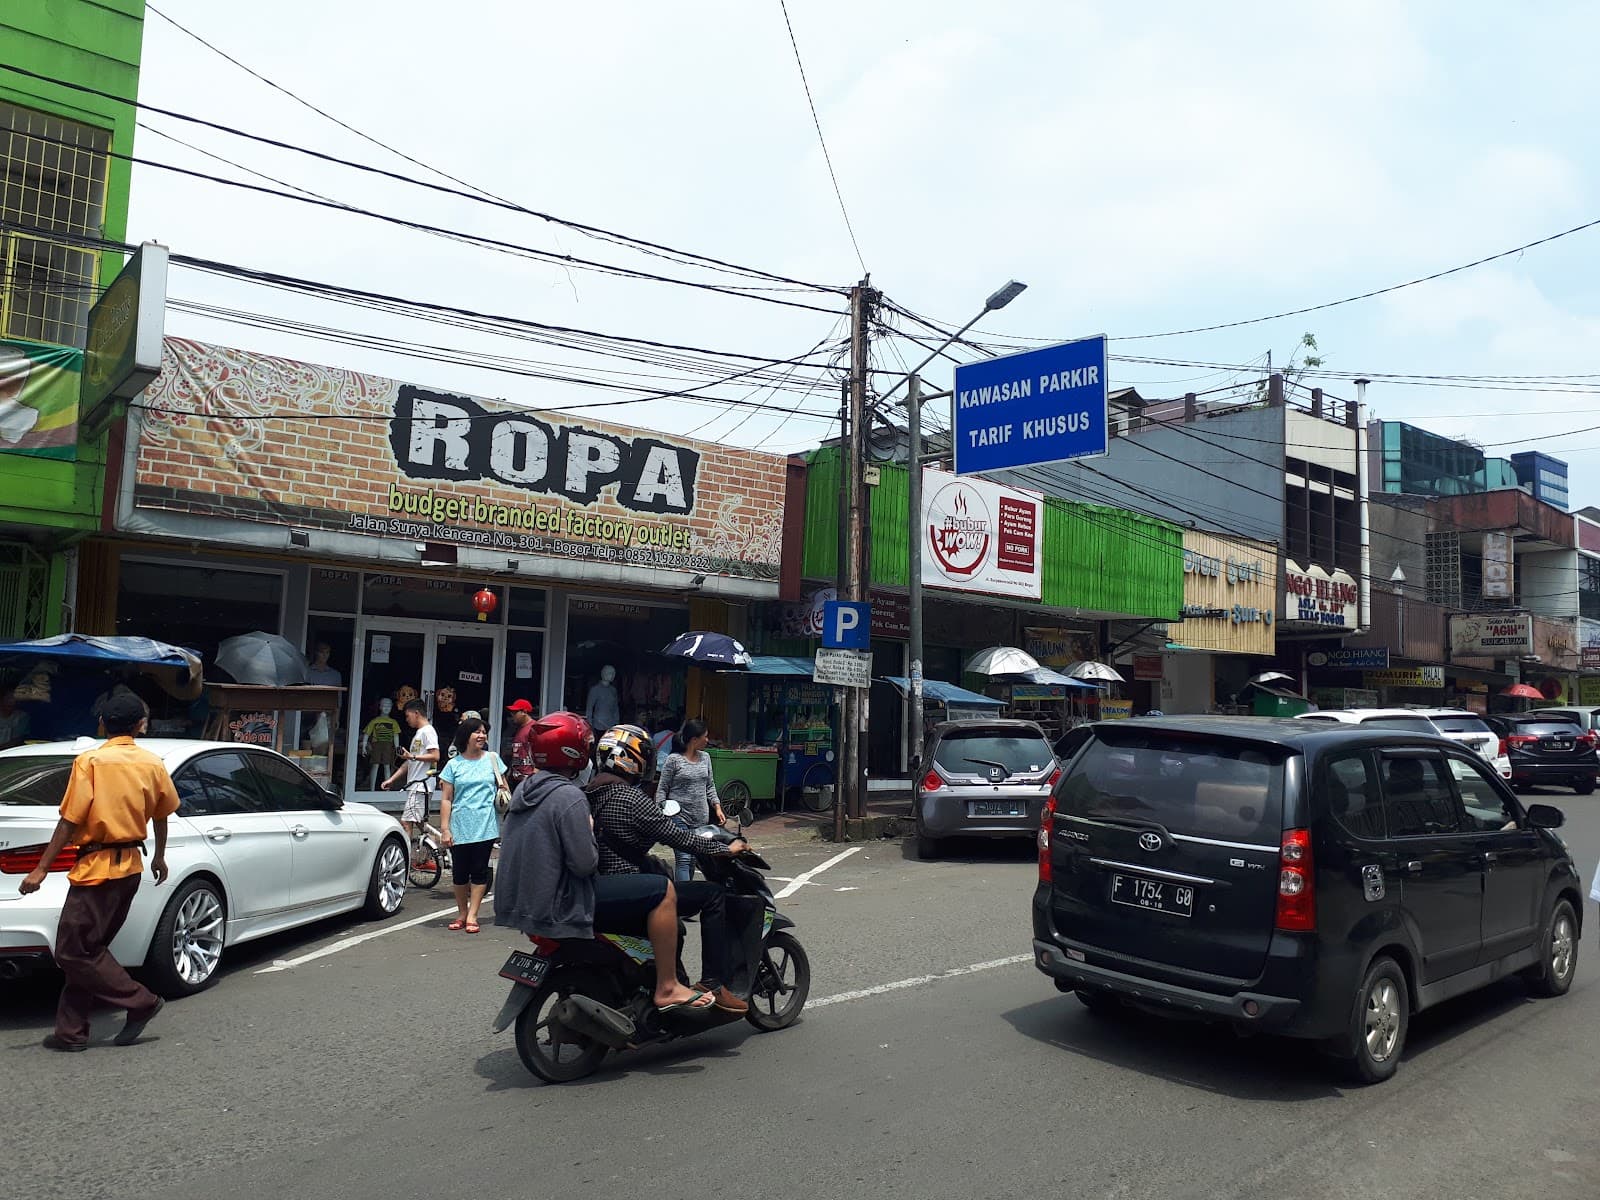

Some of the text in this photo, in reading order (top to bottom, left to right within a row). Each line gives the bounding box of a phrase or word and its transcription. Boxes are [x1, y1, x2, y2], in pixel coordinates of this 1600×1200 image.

[960, 365, 1099, 409] KAWASAN PARKIR
[969, 411, 1090, 448] TARIF KHUSUS
[408, 398, 687, 508] ROPA
[388, 483, 691, 549] budget branded factory outlet
[943, 515, 986, 531] #bubur
[349, 514, 387, 531] Jalan
[390, 519, 430, 538] Surya
[434, 525, 490, 544] Kencana
[494, 533, 516, 548] No.
[519, 536, 542, 549] 301
[553, 540, 590, 557] Bogor
[625, 549, 652, 563] 0852
[655, 553, 681, 566] 1928
[684, 556, 711, 569] 2822
[944, 531, 983, 550] WOW!
[1285, 573, 1357, 603] NGO HIANG
[836, 607, 859, 642] P
[1352, 649, 1385, 658] HIANG
[461, 672, 481, 681] BUKA
[1114, 876, 1123, 892] F
[1135, 880, 1163, 900] 1754
